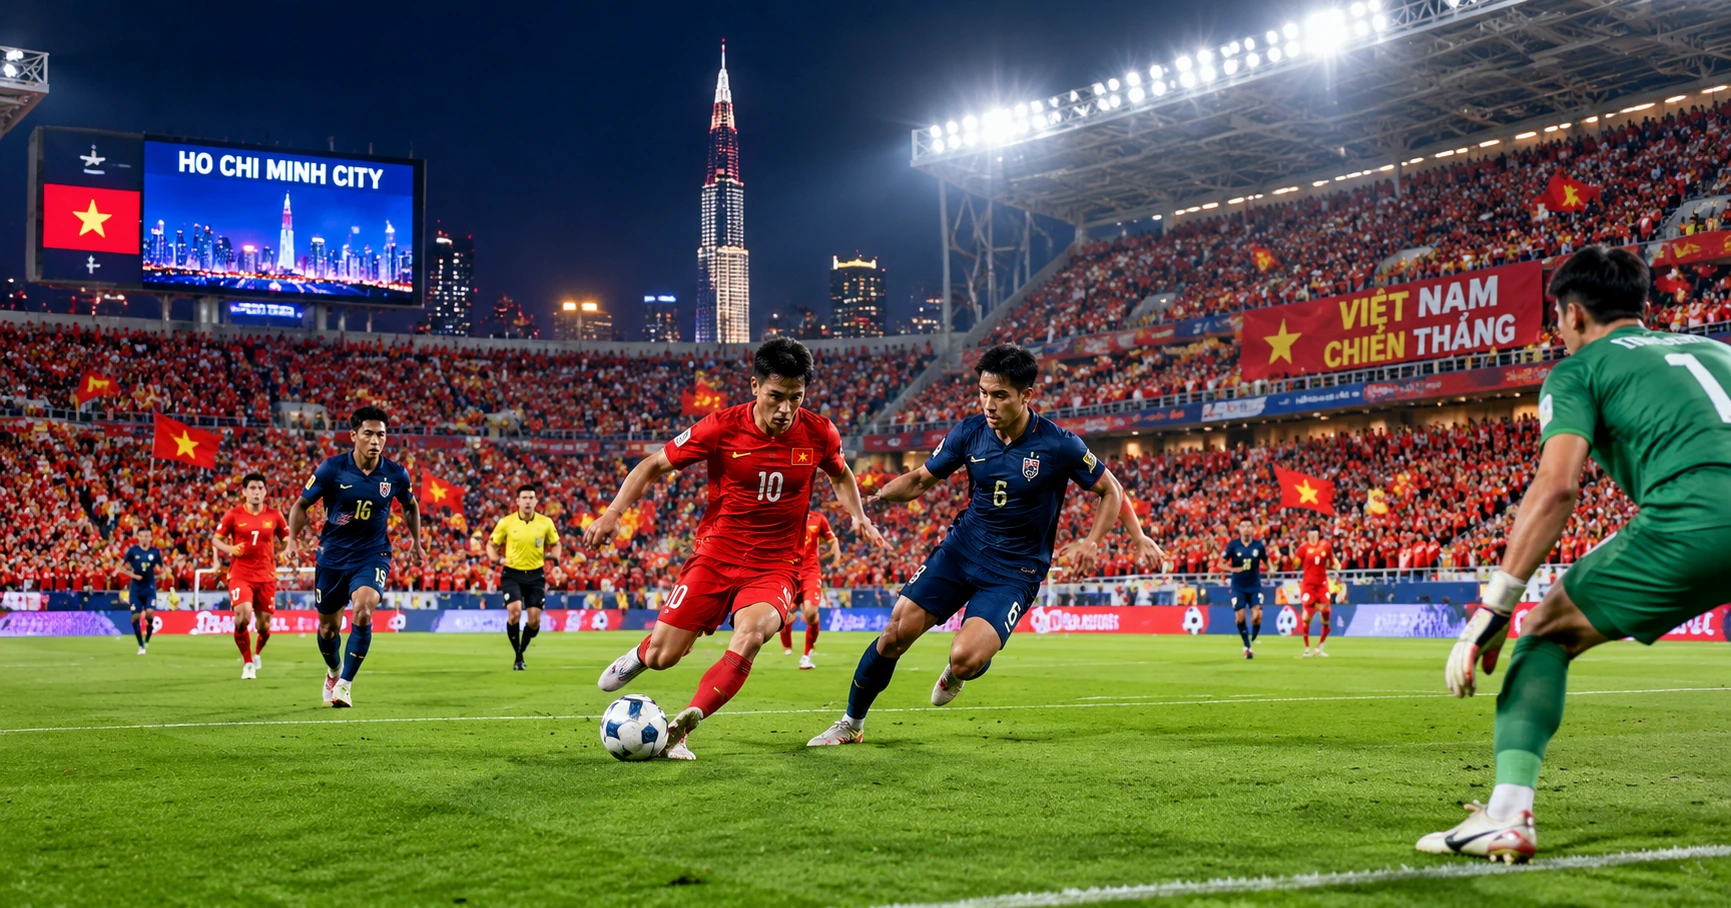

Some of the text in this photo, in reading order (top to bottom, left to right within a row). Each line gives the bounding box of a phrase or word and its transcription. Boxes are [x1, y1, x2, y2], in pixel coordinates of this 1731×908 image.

[178, 150, 384, 190] HO CHI MINH CITY
[1417, 274, 1499, 318] NAM
[757, 471, 784, 503] 10
[993, 480, 1008, 508] 6
[354, 500, 373, 521] 16
[251, 530, 260, 546] 7
[665, 584, 689, 609] 10
